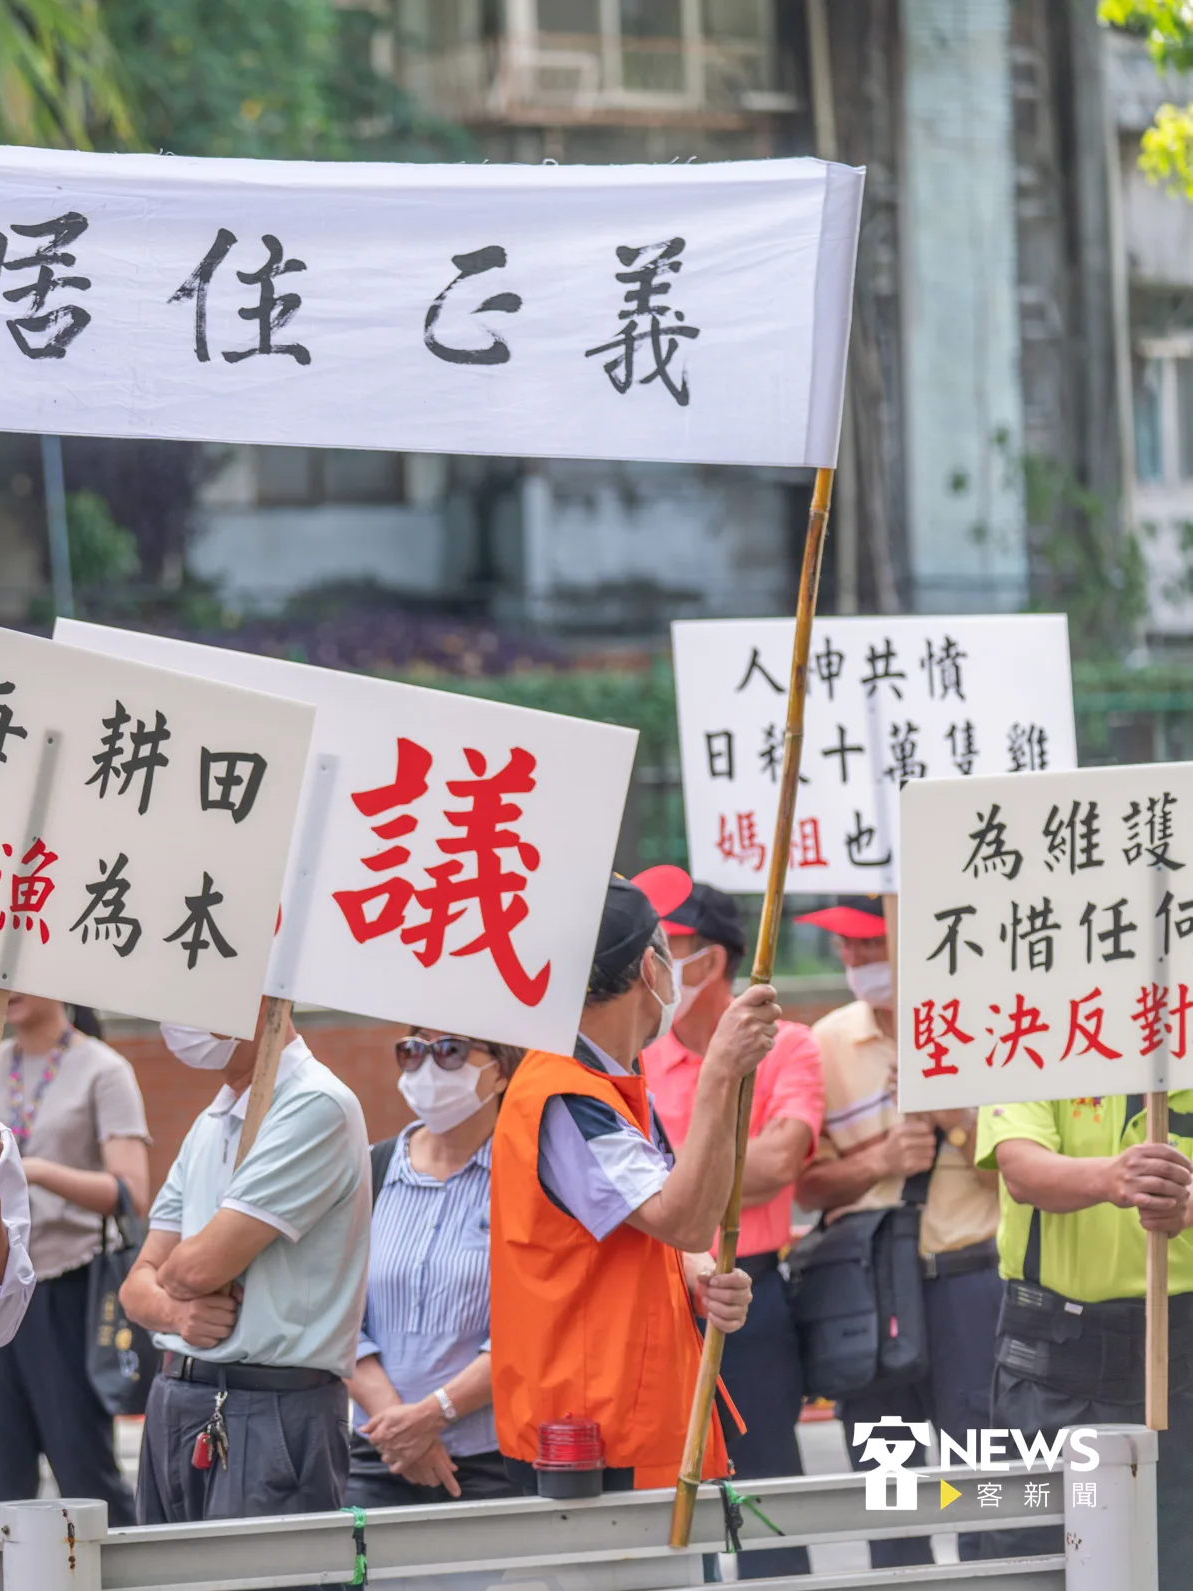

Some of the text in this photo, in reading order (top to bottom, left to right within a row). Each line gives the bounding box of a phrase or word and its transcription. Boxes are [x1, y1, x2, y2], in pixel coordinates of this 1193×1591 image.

[736, 635, 968, 702] 人神共憤
[274, 737, 551, 1007] 議
[963, 791, 1186, 881] 為維護
[913, 982, 1193, 1079] 堅決反對
